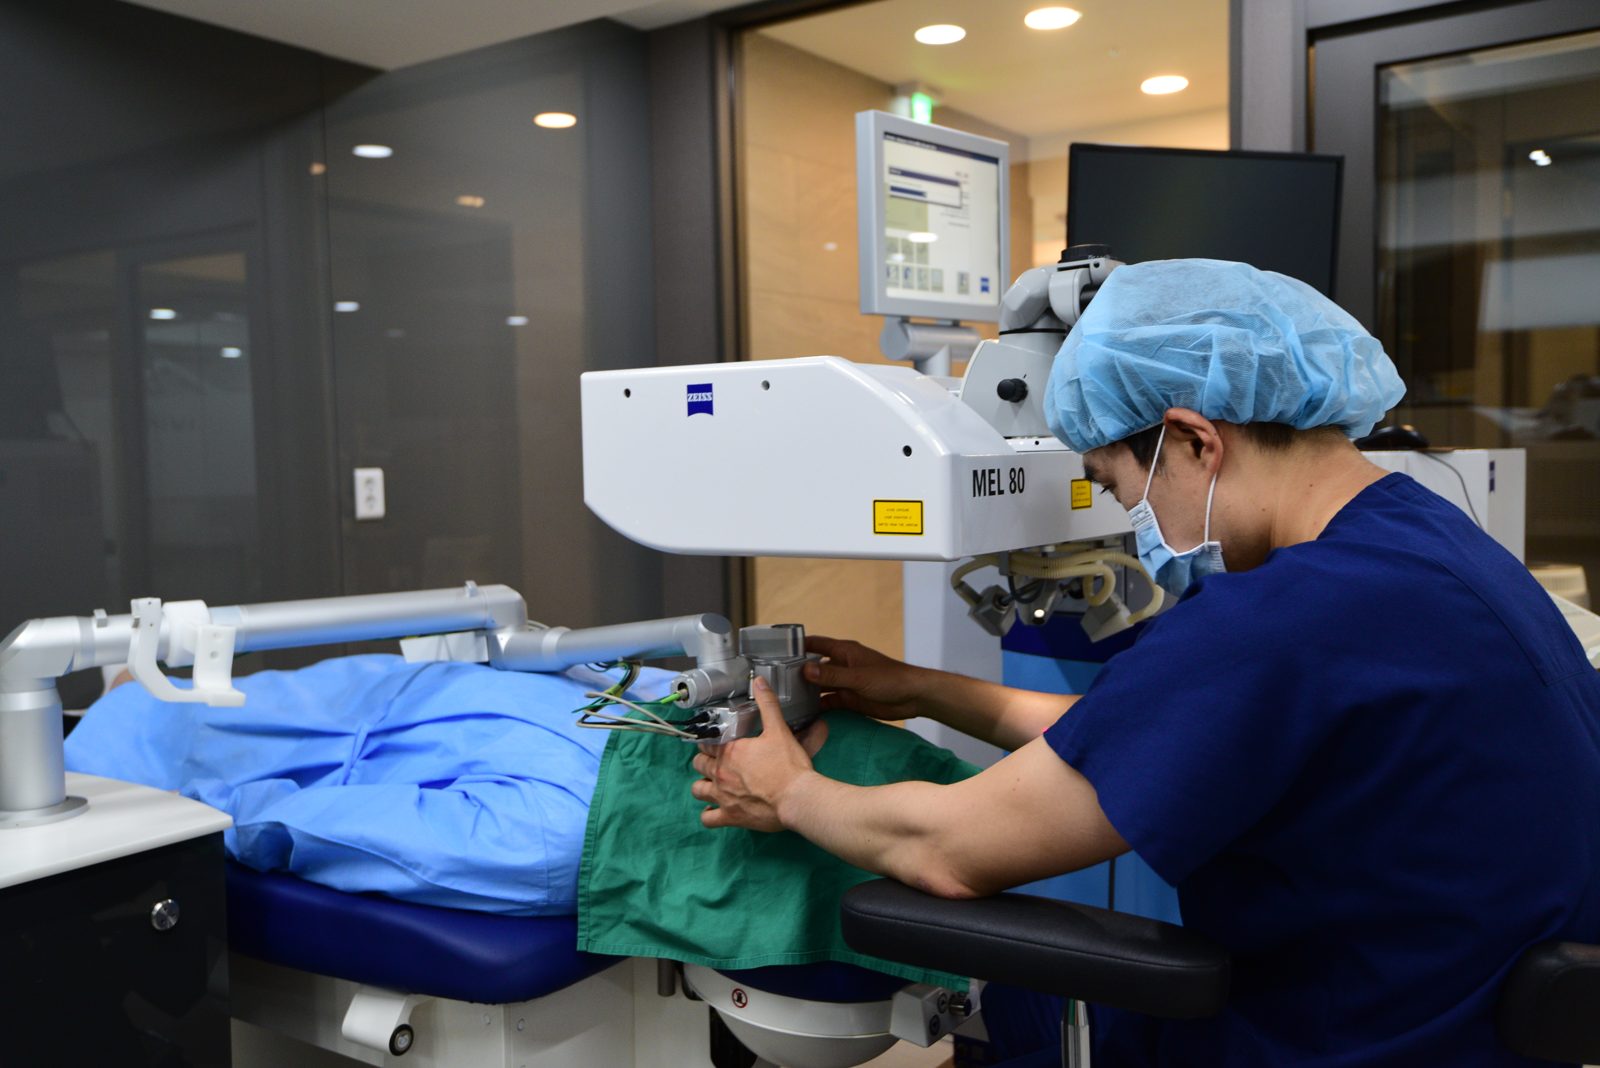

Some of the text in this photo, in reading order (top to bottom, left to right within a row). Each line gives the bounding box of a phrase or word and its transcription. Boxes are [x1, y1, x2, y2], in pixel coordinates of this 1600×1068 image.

[687, 392, 713, 402] ZEISS
[972, 466, 1025, 498] MEL 80
